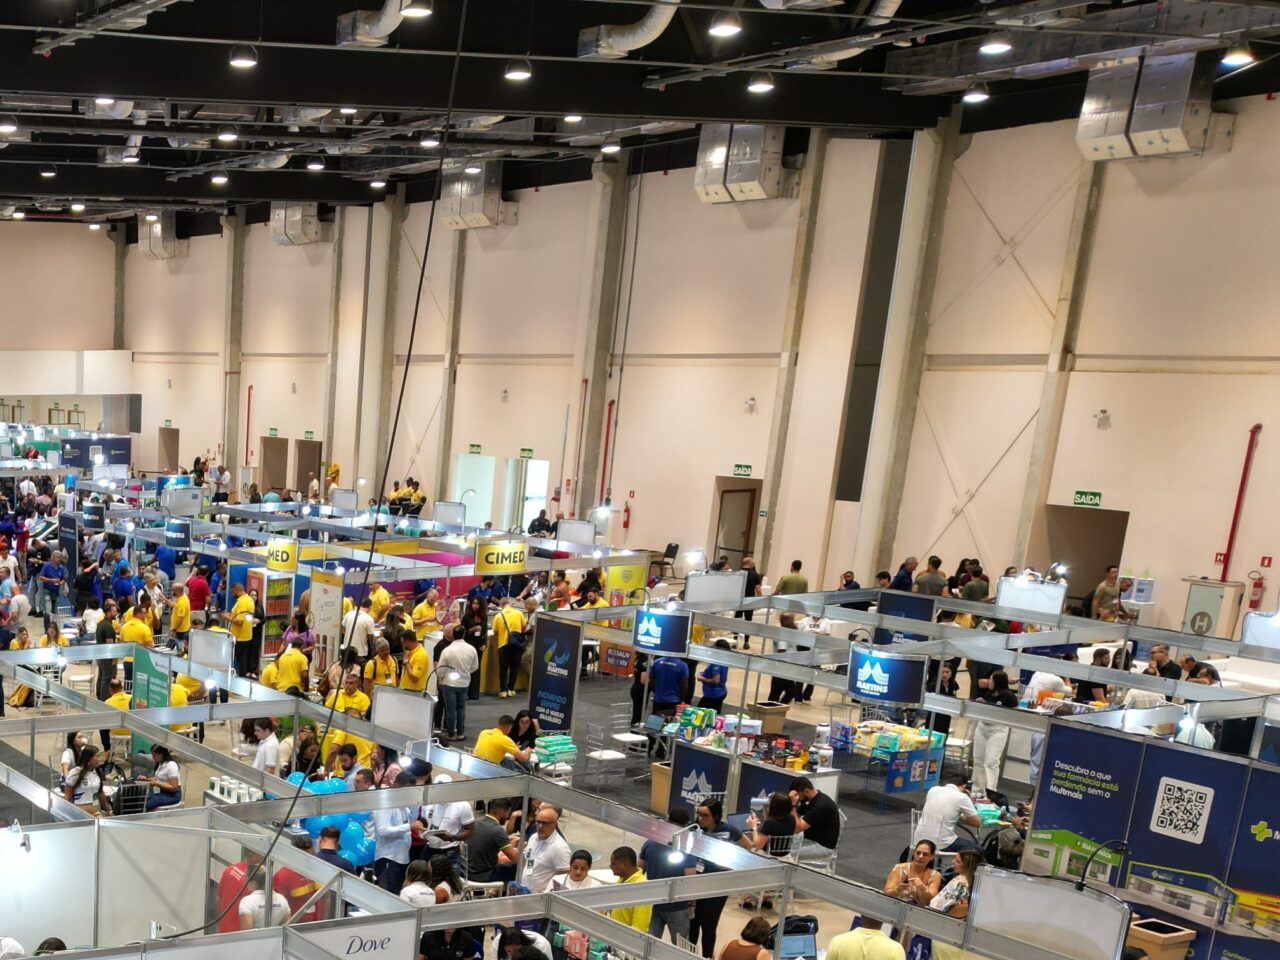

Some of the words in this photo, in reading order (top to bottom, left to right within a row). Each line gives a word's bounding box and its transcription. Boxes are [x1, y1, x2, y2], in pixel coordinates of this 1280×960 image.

[734, 465, 752, 476] SAÍDA
[1074, 492, 1101, 505] SAÍDA
[484, 550, 524, 565] CIMED
[857, 680, 888, 693] MARTINS
[1055, 760, 1089, 776] Descubra
[1097, 772, 1112, 781] que
[1051, 778, 1087, 792] perdendo
[1088, 787, 1104, 796] sem
[1053, 769, 1066, 778] sua
[1067, 772, 1101, 787] farmácia
[1102, 782, 1119, 791] está
[346, 935, 391, 955] Dove
